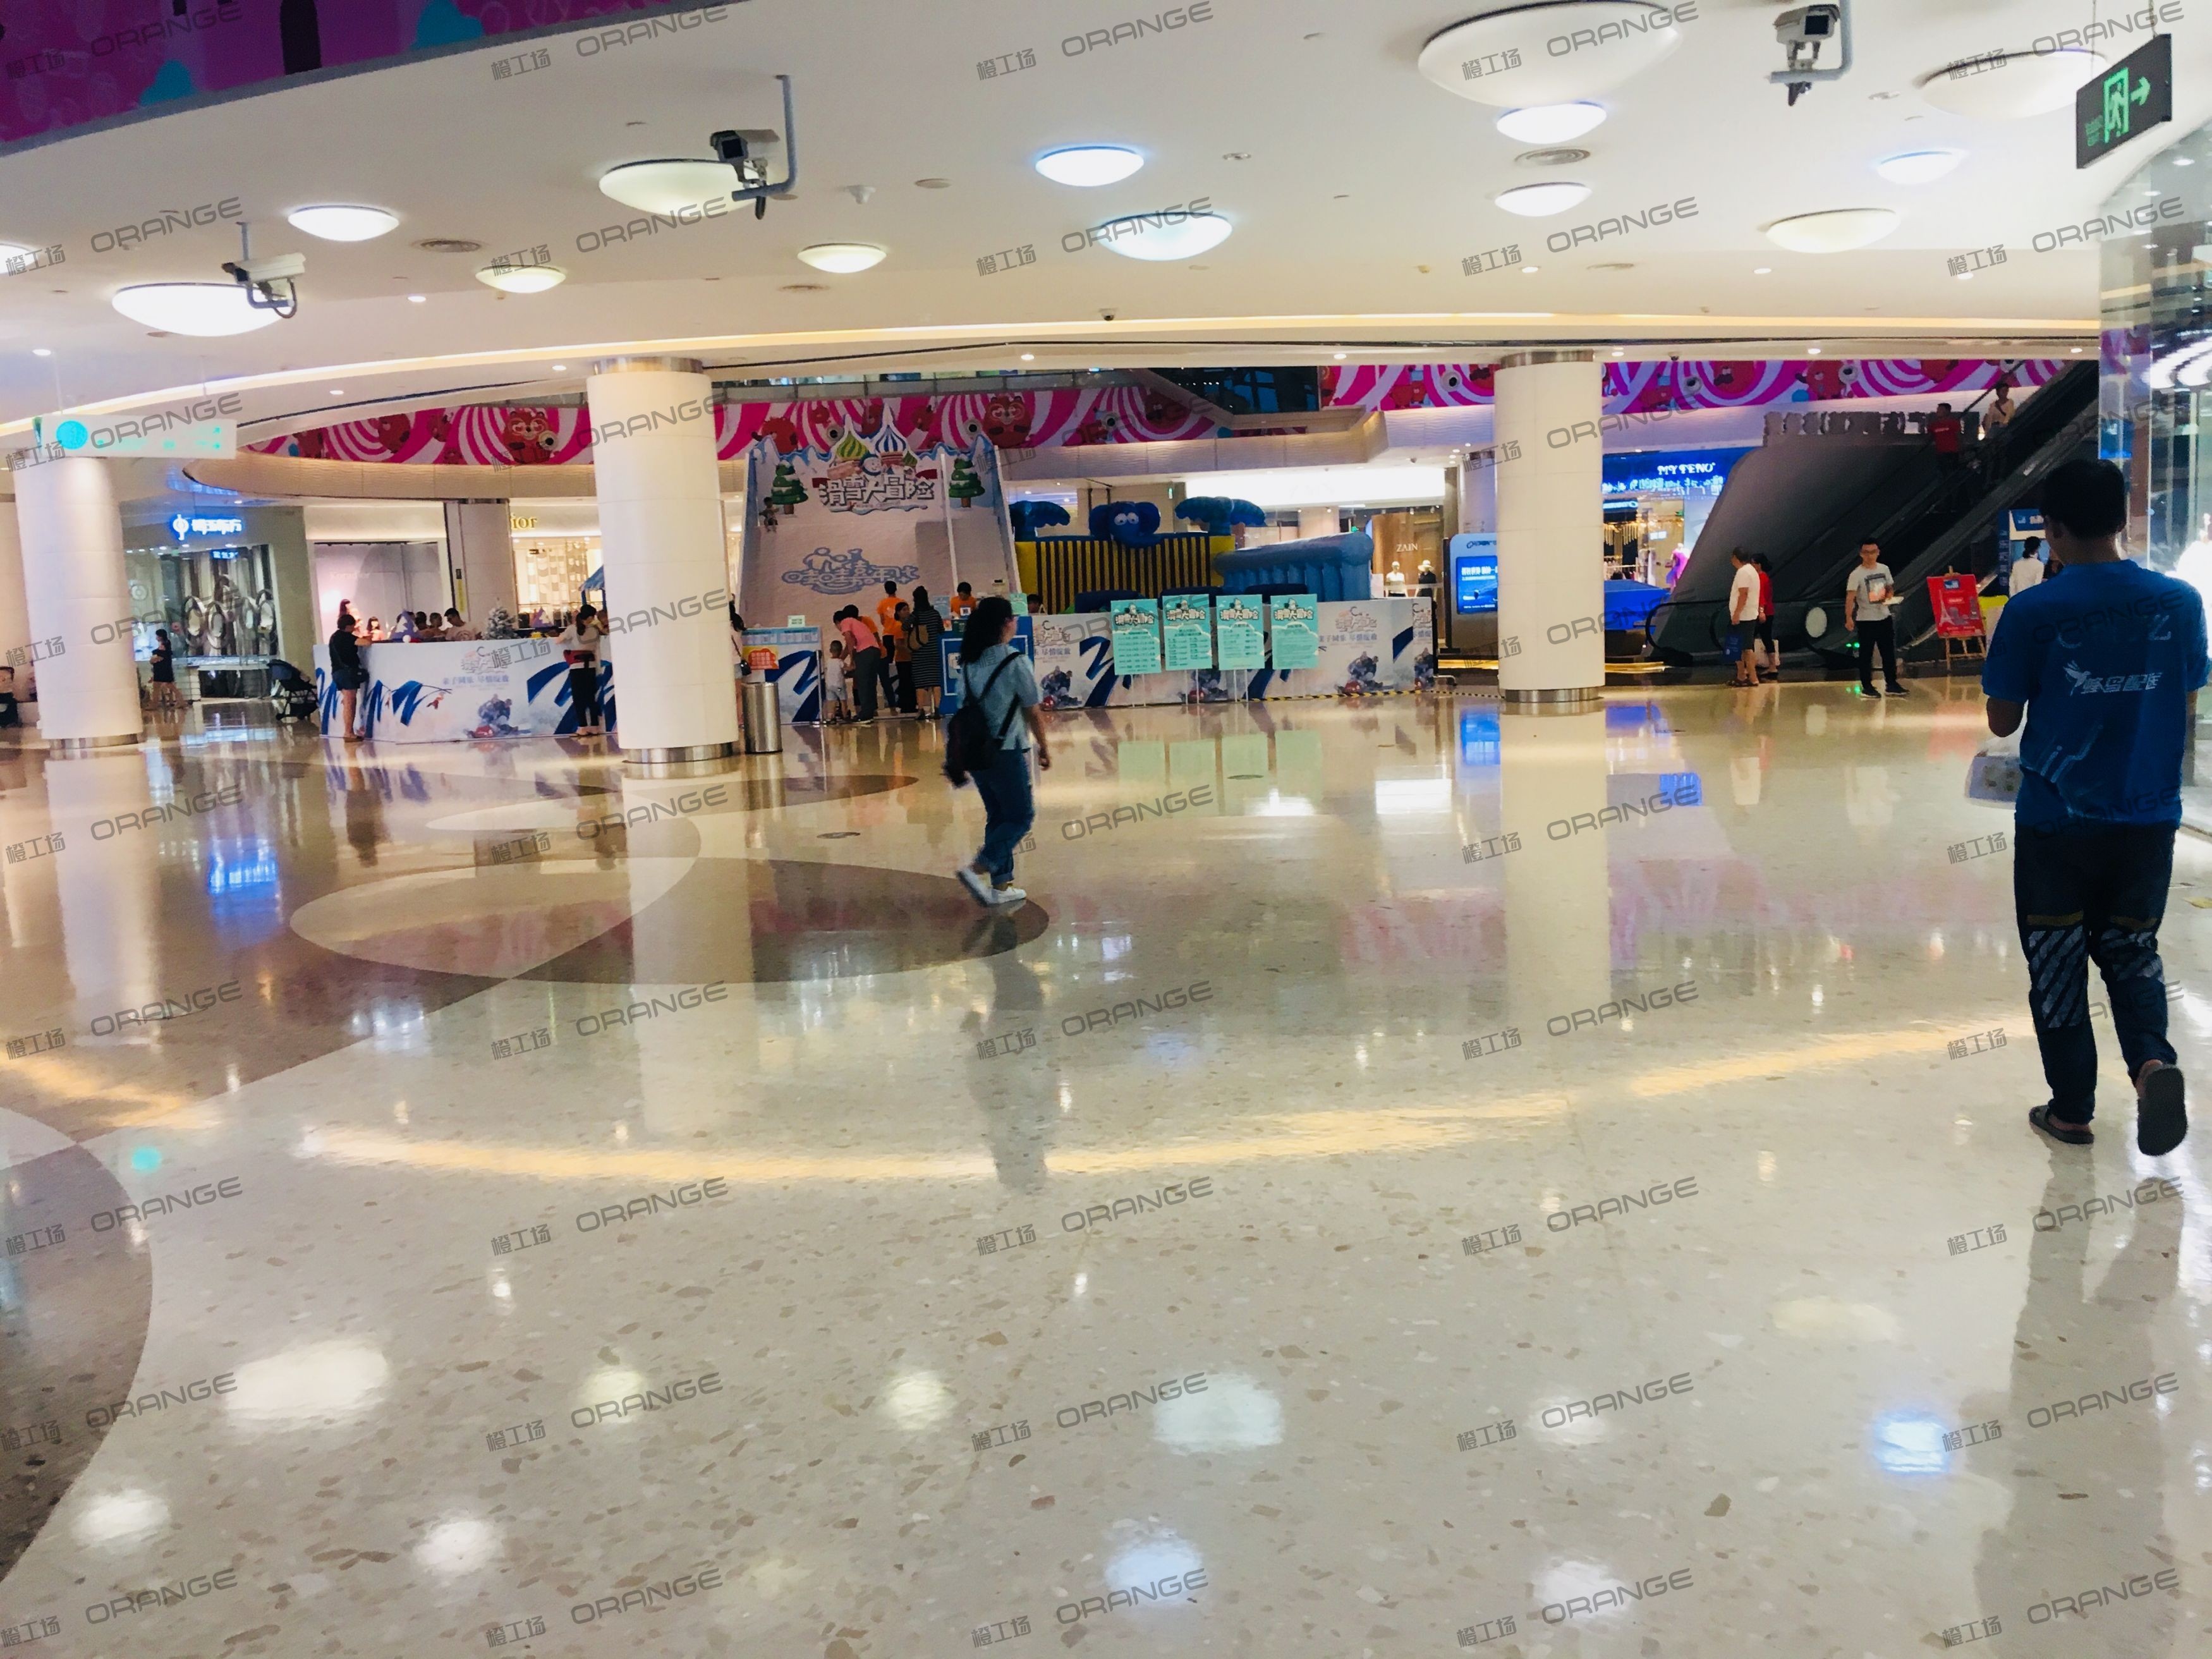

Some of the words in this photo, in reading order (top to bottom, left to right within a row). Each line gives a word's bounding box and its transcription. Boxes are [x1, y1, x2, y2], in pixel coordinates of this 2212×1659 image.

[819, 474, 935, 506] 滑雪大冒险
[510, 513, 537, 529] ior
[1396, 543, 1418, 552] ZAIN
